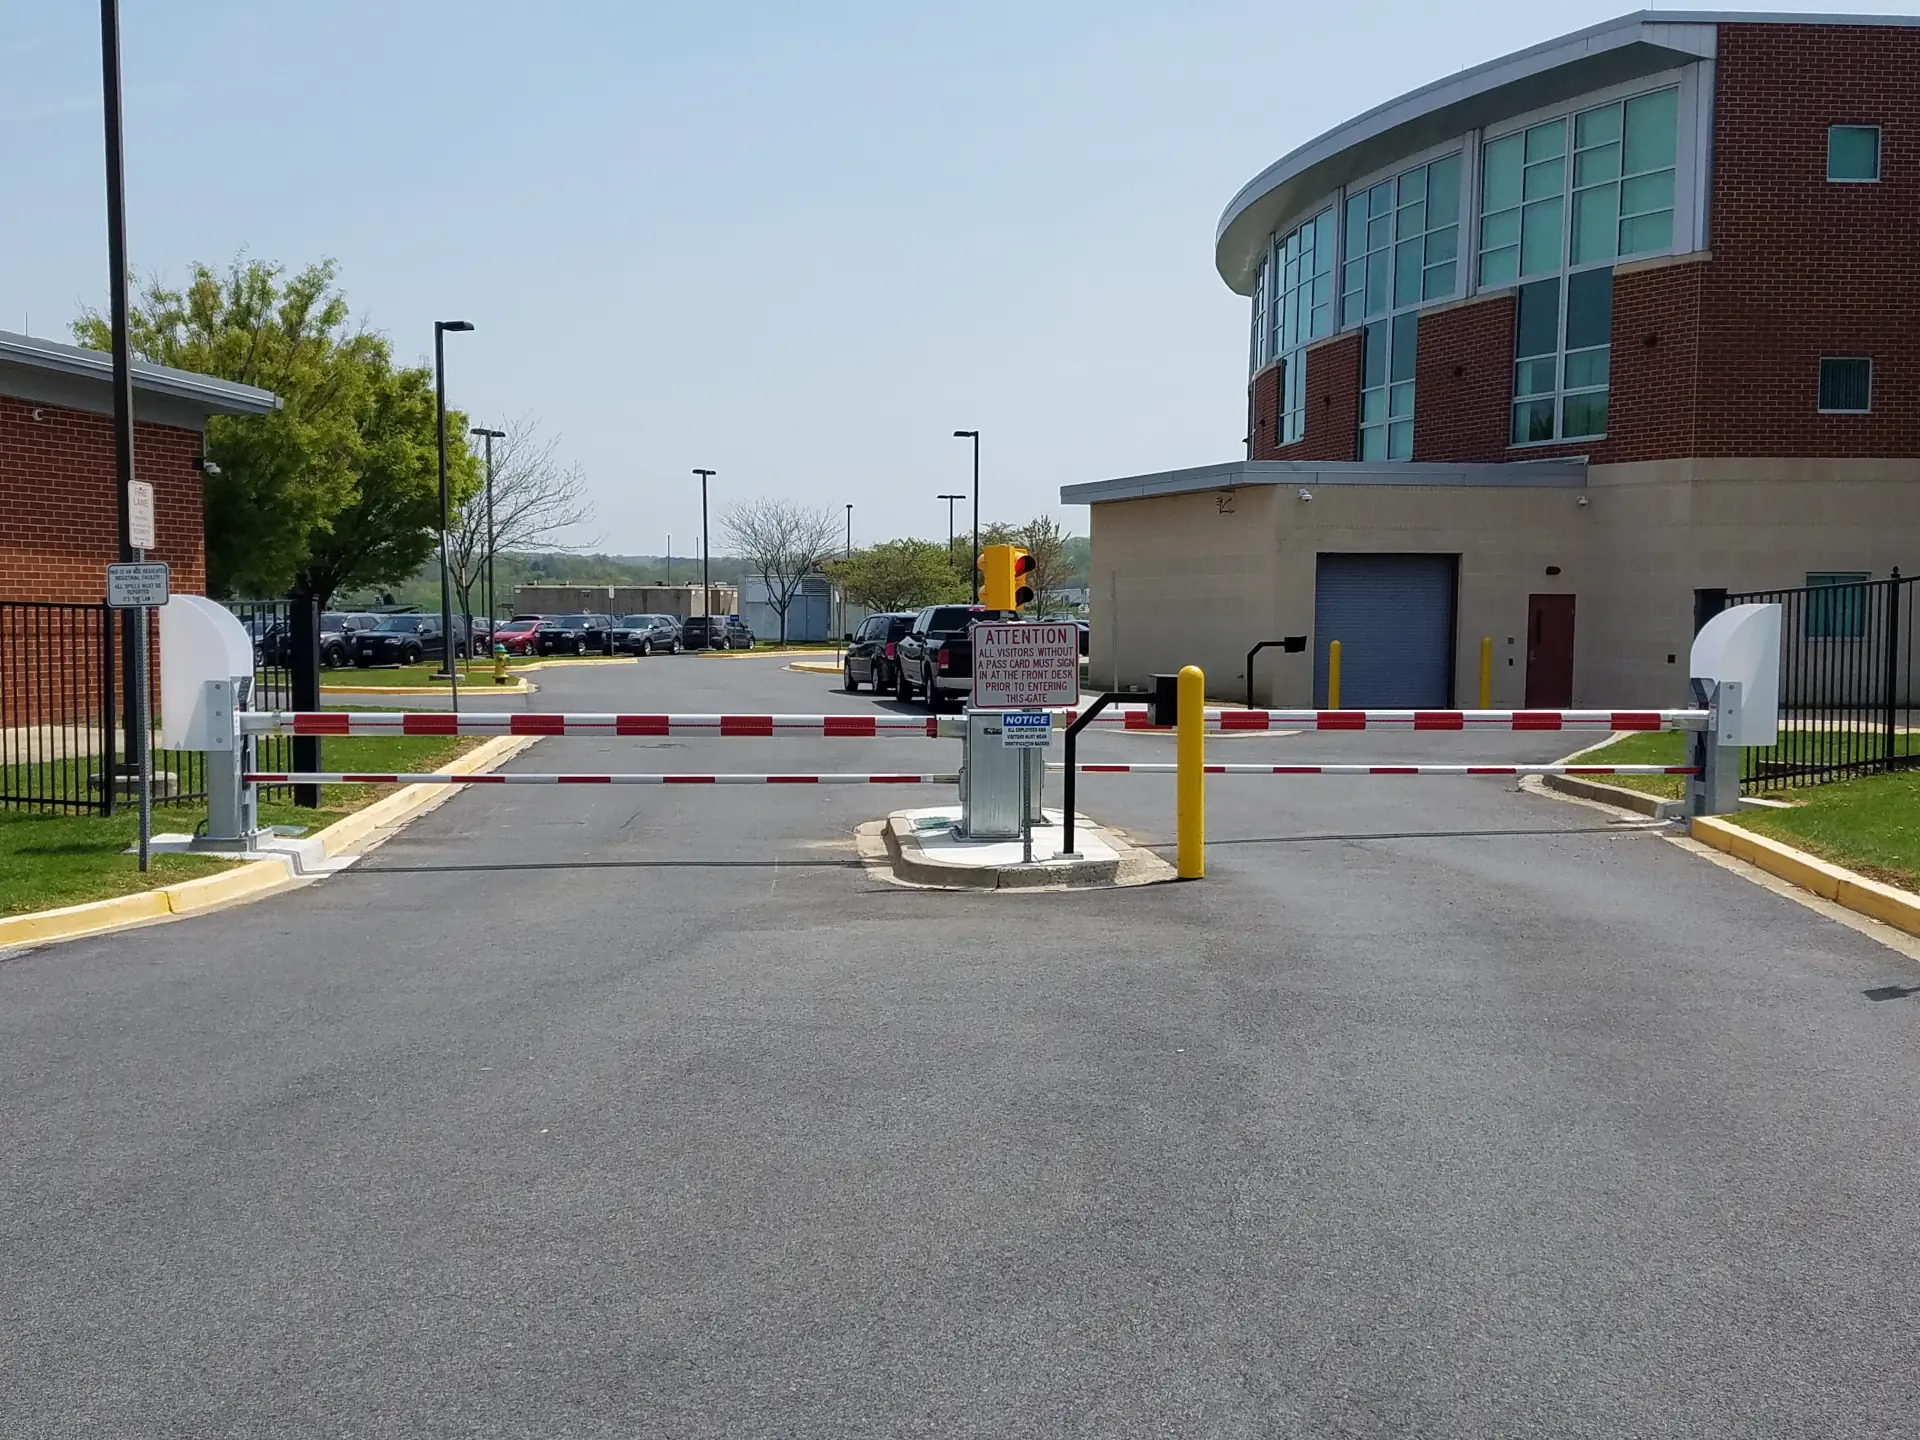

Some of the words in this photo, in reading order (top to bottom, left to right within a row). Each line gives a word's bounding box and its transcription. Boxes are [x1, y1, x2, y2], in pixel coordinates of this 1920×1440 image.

[133, 497, 149, 508] LANE
[985, 628, 1067, 645] ATTENTION
[979, 649, 994, 658] ALL
[997, 648, 1034, 657] VISITORS
[1038, 647, 1074, 656] WITHOUT
[978, 660, 984, 669] A
[986, 660, 1007, 669] PASS
[1010, 659, 1030, 668] CARD
[1033, 659, 1054, 668] MUST
[1056, 658, 1075, 668] SIGN
[980, 671, 987, 680] IN
[991, 671, 1001, 680] AT
[1004, 670, 1019, 680] THE
[1022, 670, 1048, 679] FRONT
[1052, 670, 1073, 679] DESK
[985, 682, 1011, 692] PRIOR
[1014, 682, 1024, 691] TO
[1028, 682, 1067, 691] ENTERING
[1006, 694, 1023, 703] THIS
[1026, 693, 1048, 703] GATE
[1006, 716, 1048, 724] NOTICE
